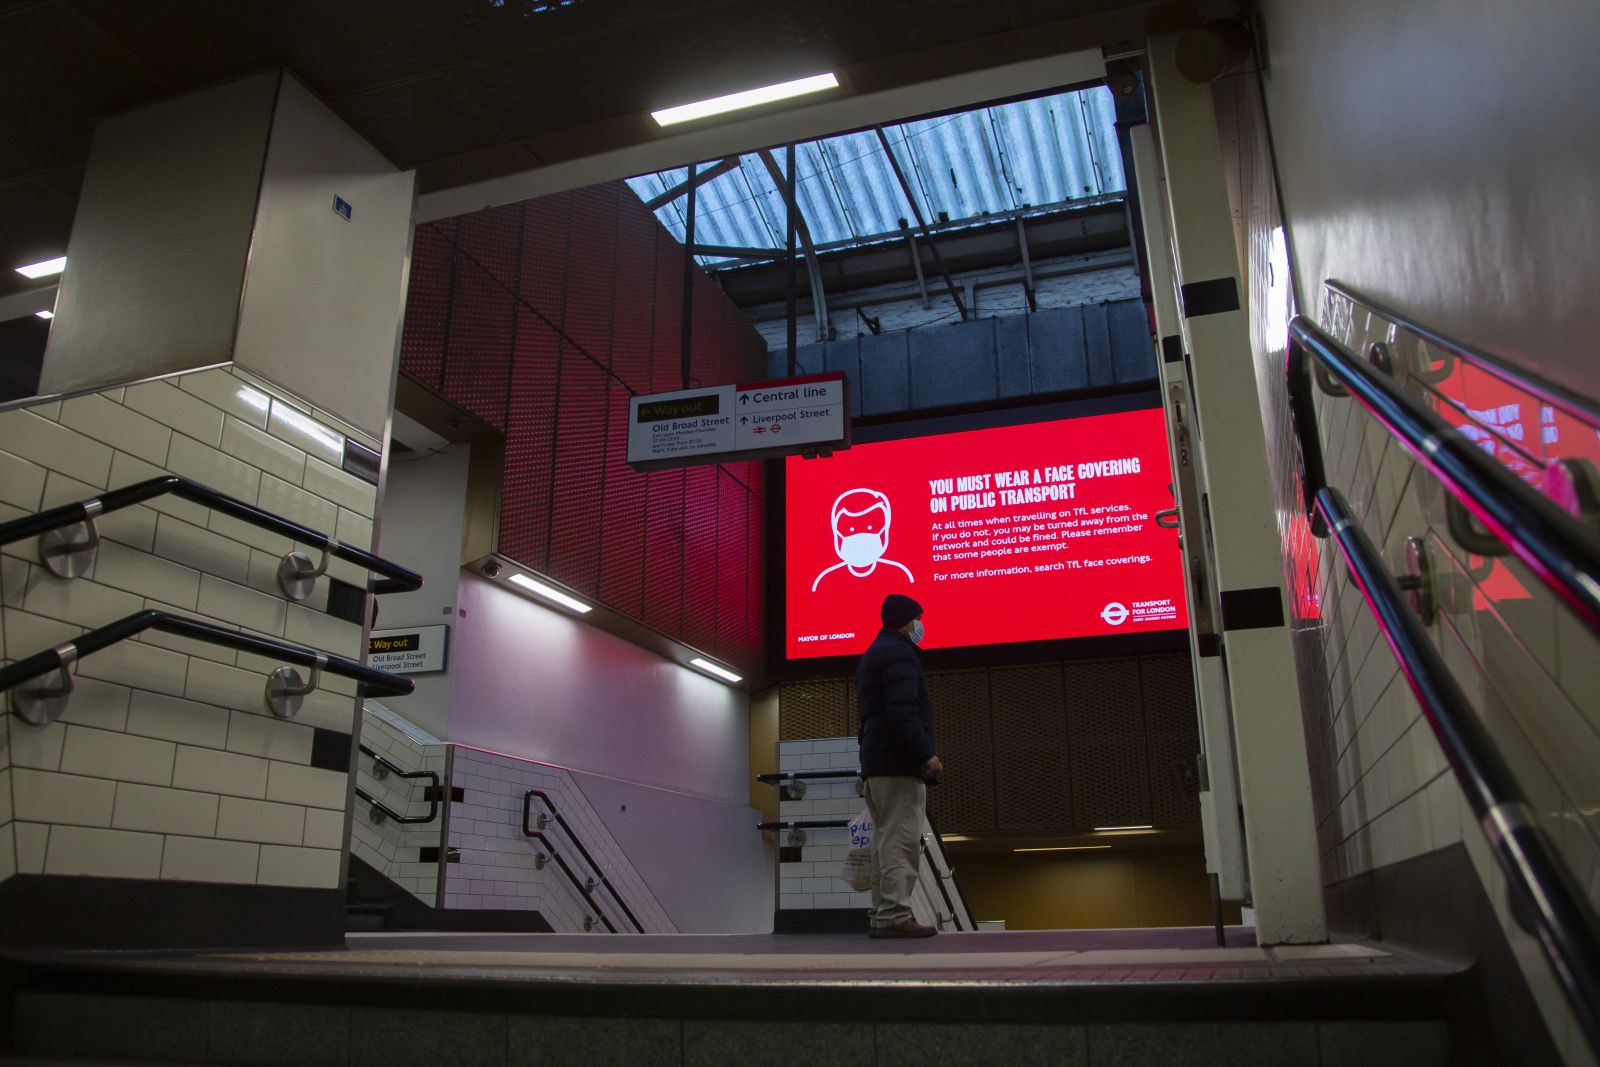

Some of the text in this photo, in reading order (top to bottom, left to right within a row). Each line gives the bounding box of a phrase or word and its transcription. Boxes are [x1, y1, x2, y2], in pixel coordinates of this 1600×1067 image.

[753, 388, 826, 403] Central line
[655, 401, 703, 416] Way out
[753, 409, 830, 423] Liverpool Street
[652, 417, 730, 432] Old Broad Street
[929, 457, 1140, 495] YOU MUST WEAR A FACE COVERING
[930, 483, 1076, 513] ON PUBLIC TRANSPORT
[958, 520, 983, 528] times
[986, 516, 1010, 525] when
[1013, 512, 1056, 522] travelling
[1073, 507, 1088, 515] TfL
[1091, 504, 1132, 514] services.
[941, 533, 957, 541] you
[993, 527, 1010, 536] you
[1013, 526, 1031, 534] may
[1047, 520, 1078, 529] turned
[1081, 518, 1104, 526] away
[1106, 515, 1129, 524] from
[933, 541, 970, 551] network
[972, 539, 989, 547] and
[992, 536, 1016, 545] could
[1033, 532, 1059, 541] fined.
[1062, 529, 1091, 539] Please
[1094, 524, 1143, 535] remember
[933, 553, 951, 562] that
[954, 551, 978, 559] some
[980, 547, 1012, 558] people
[1031, 542, 1069, 552] exempt.
[950, 571, 974, 580] more
[1034, 562, 1064, 572] search
[1066, 560, 1082, 568] TfL
[1084, 559, 1103, 568] face
[1106, 555, 1152, 565] coverings.
[1132, 599, 1171, 608] TRANSPORT
[1147, 606, 1176, 614] LONDON
[374, 639, 408, 650] Way out
[373, 662, 401, 671] Liverpool
